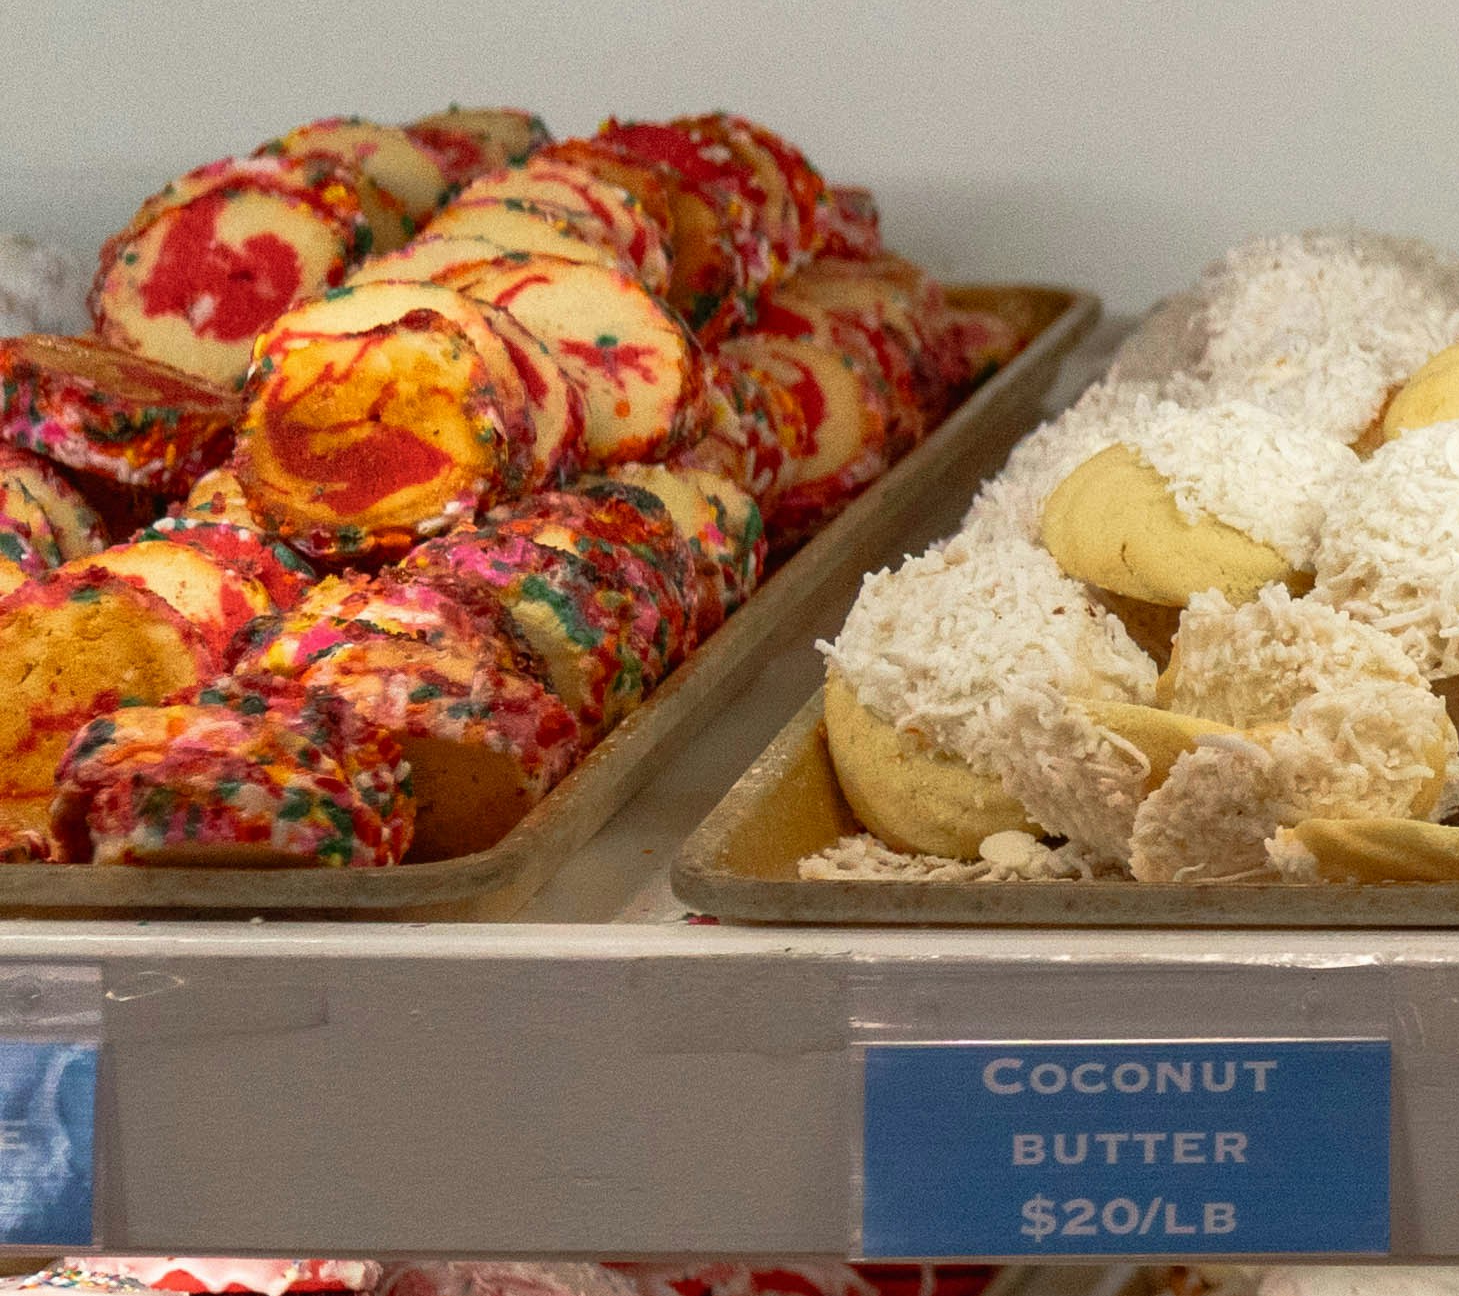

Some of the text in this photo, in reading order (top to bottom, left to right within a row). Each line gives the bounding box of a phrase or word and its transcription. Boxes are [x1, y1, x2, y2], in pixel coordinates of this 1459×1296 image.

[984, 1058, 1277, 1094] COCONUT
[1012, 1131, 1248, 1166] BUTTER
[1020, 1194, 1237, 1242] $20/LB
